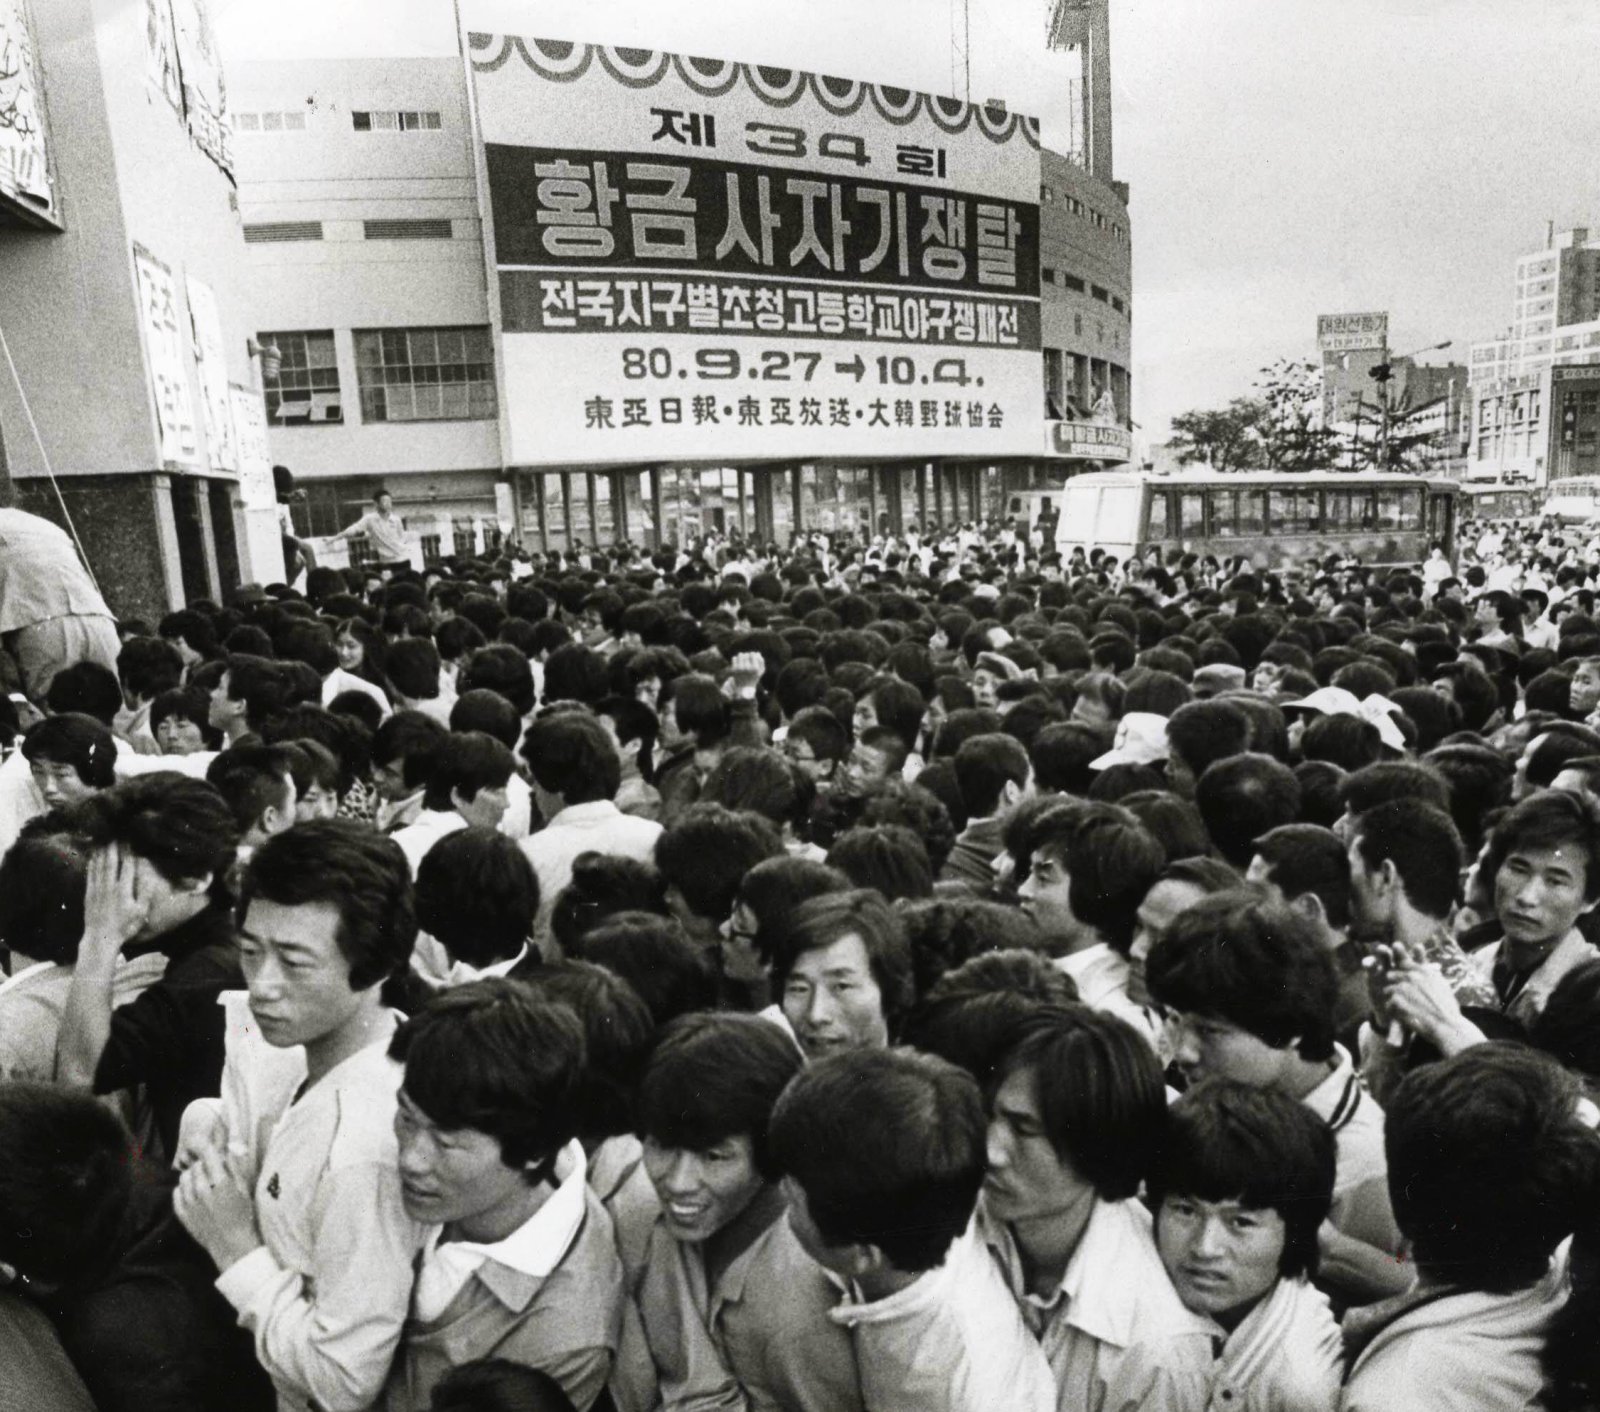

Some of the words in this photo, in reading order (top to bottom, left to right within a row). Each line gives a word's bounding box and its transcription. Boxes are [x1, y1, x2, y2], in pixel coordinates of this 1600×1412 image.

[650, 107, 716, 148] 제
[745, 121, 872, 167] 34
[896, 144, 947, 179] 회
